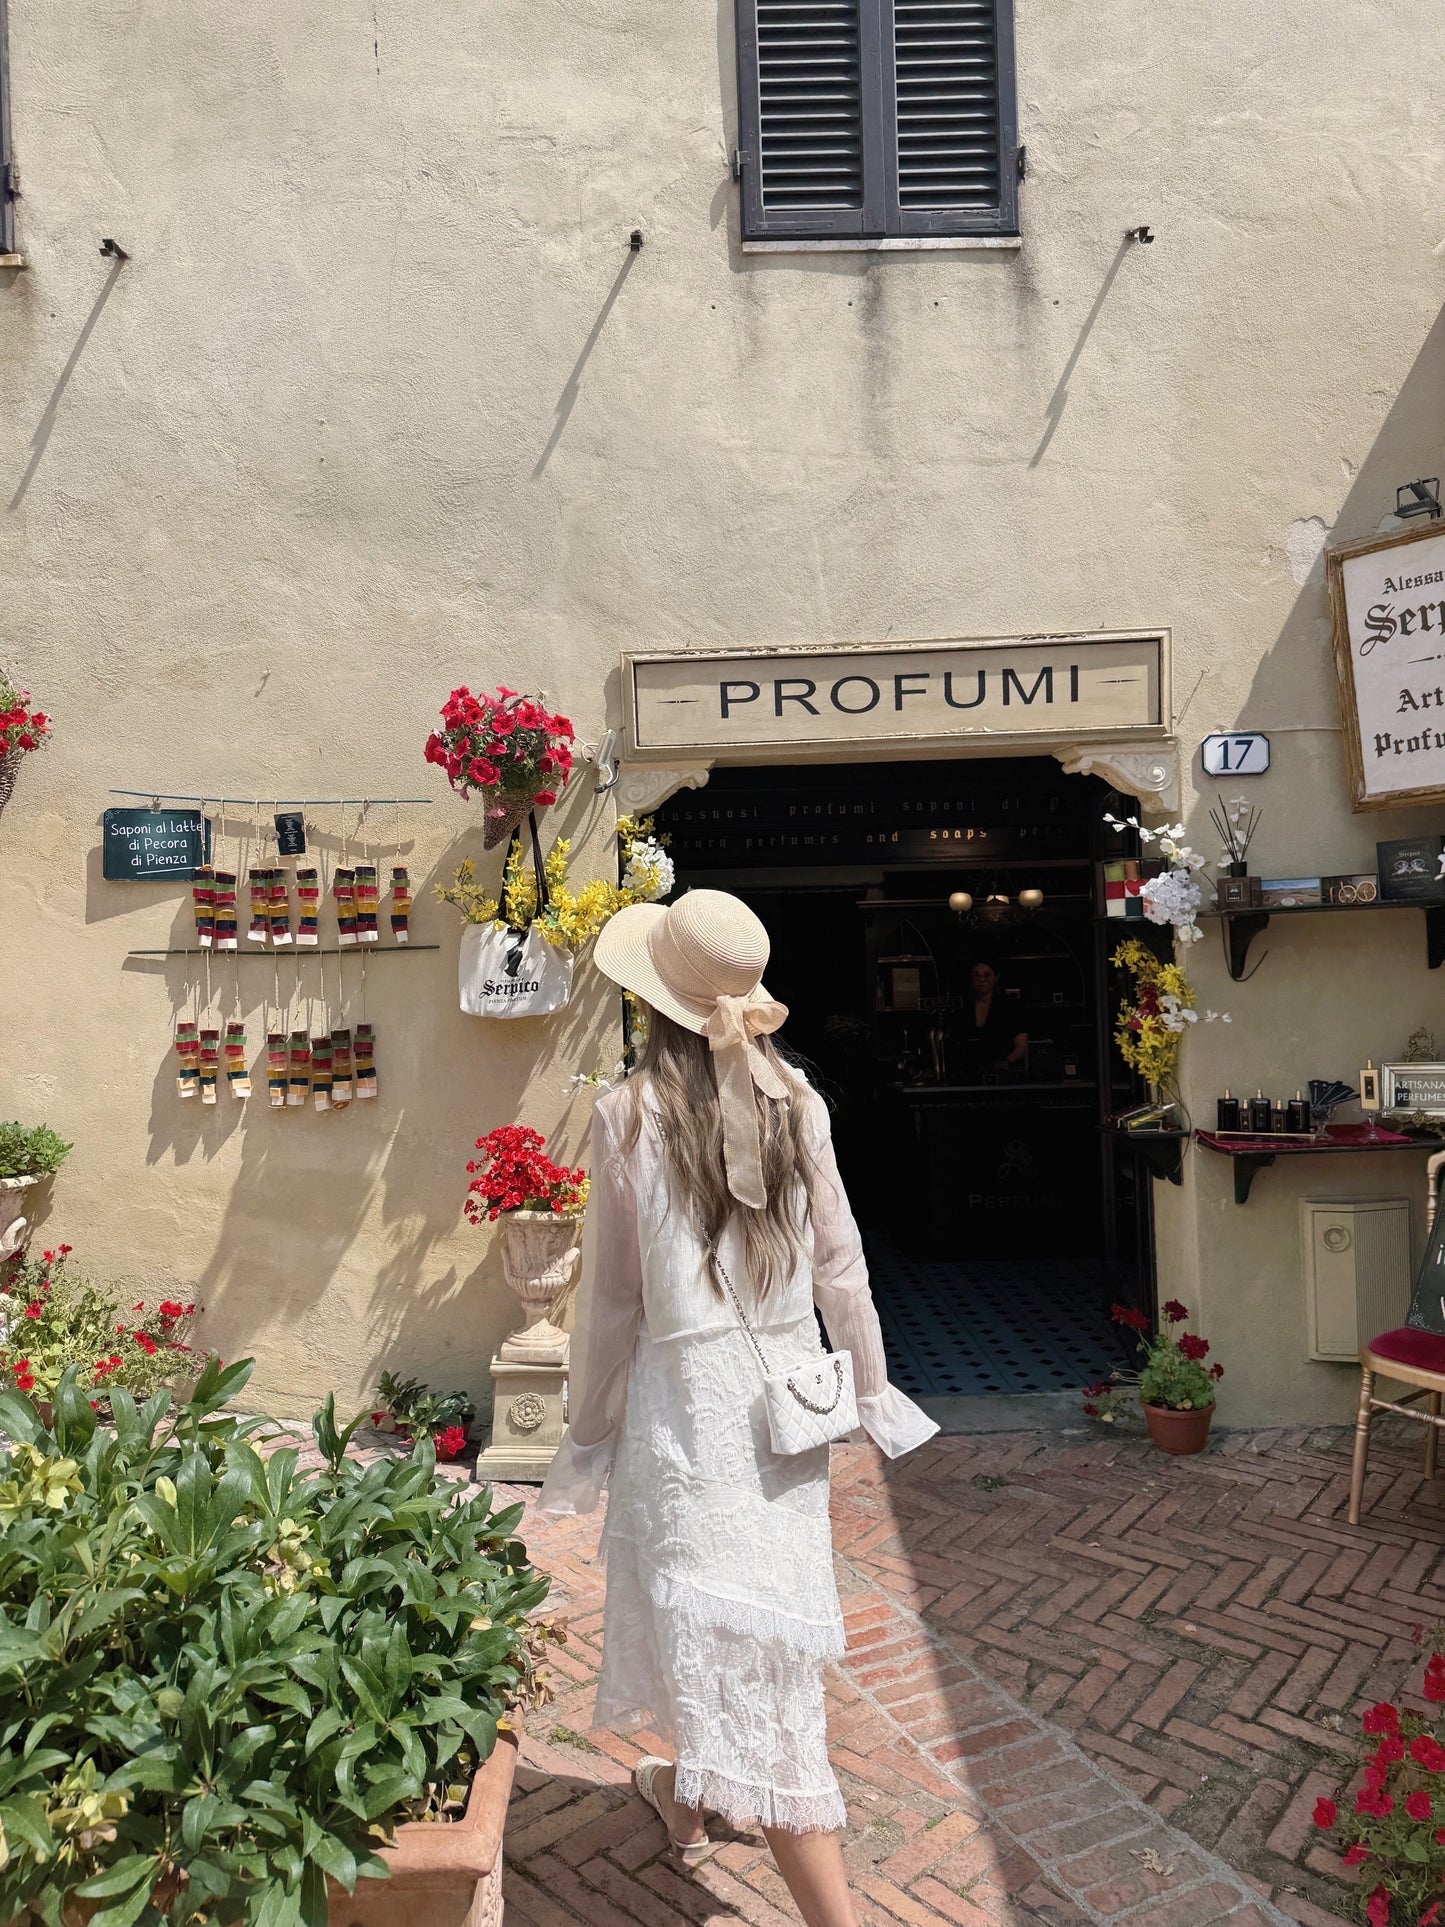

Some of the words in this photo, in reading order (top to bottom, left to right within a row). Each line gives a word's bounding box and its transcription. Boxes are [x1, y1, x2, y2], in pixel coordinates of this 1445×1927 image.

[1382, 570, 1445, 595] Alessa
[720, 664, 1080, 719] PROFUMI
[1396, 686, 1444, 713] Art
[1217, 739, 1254, 770] 17
[788, 801, 876, 817] profumi
[902, 798, 976, 812] saponi
[111, 823, 151, 838] Saponi
[155, 821, 167, 834] al
[866, 831, 899, 844] and
[929, 826, 988, 840] soaps
[128, 838, 140, 851] di
[144, 837, 188, 850] Pecora
[131, 854, 142, 866] di
[146, 853, 187, 866] Pienza
[479, 979, 539, 999] Serpico
